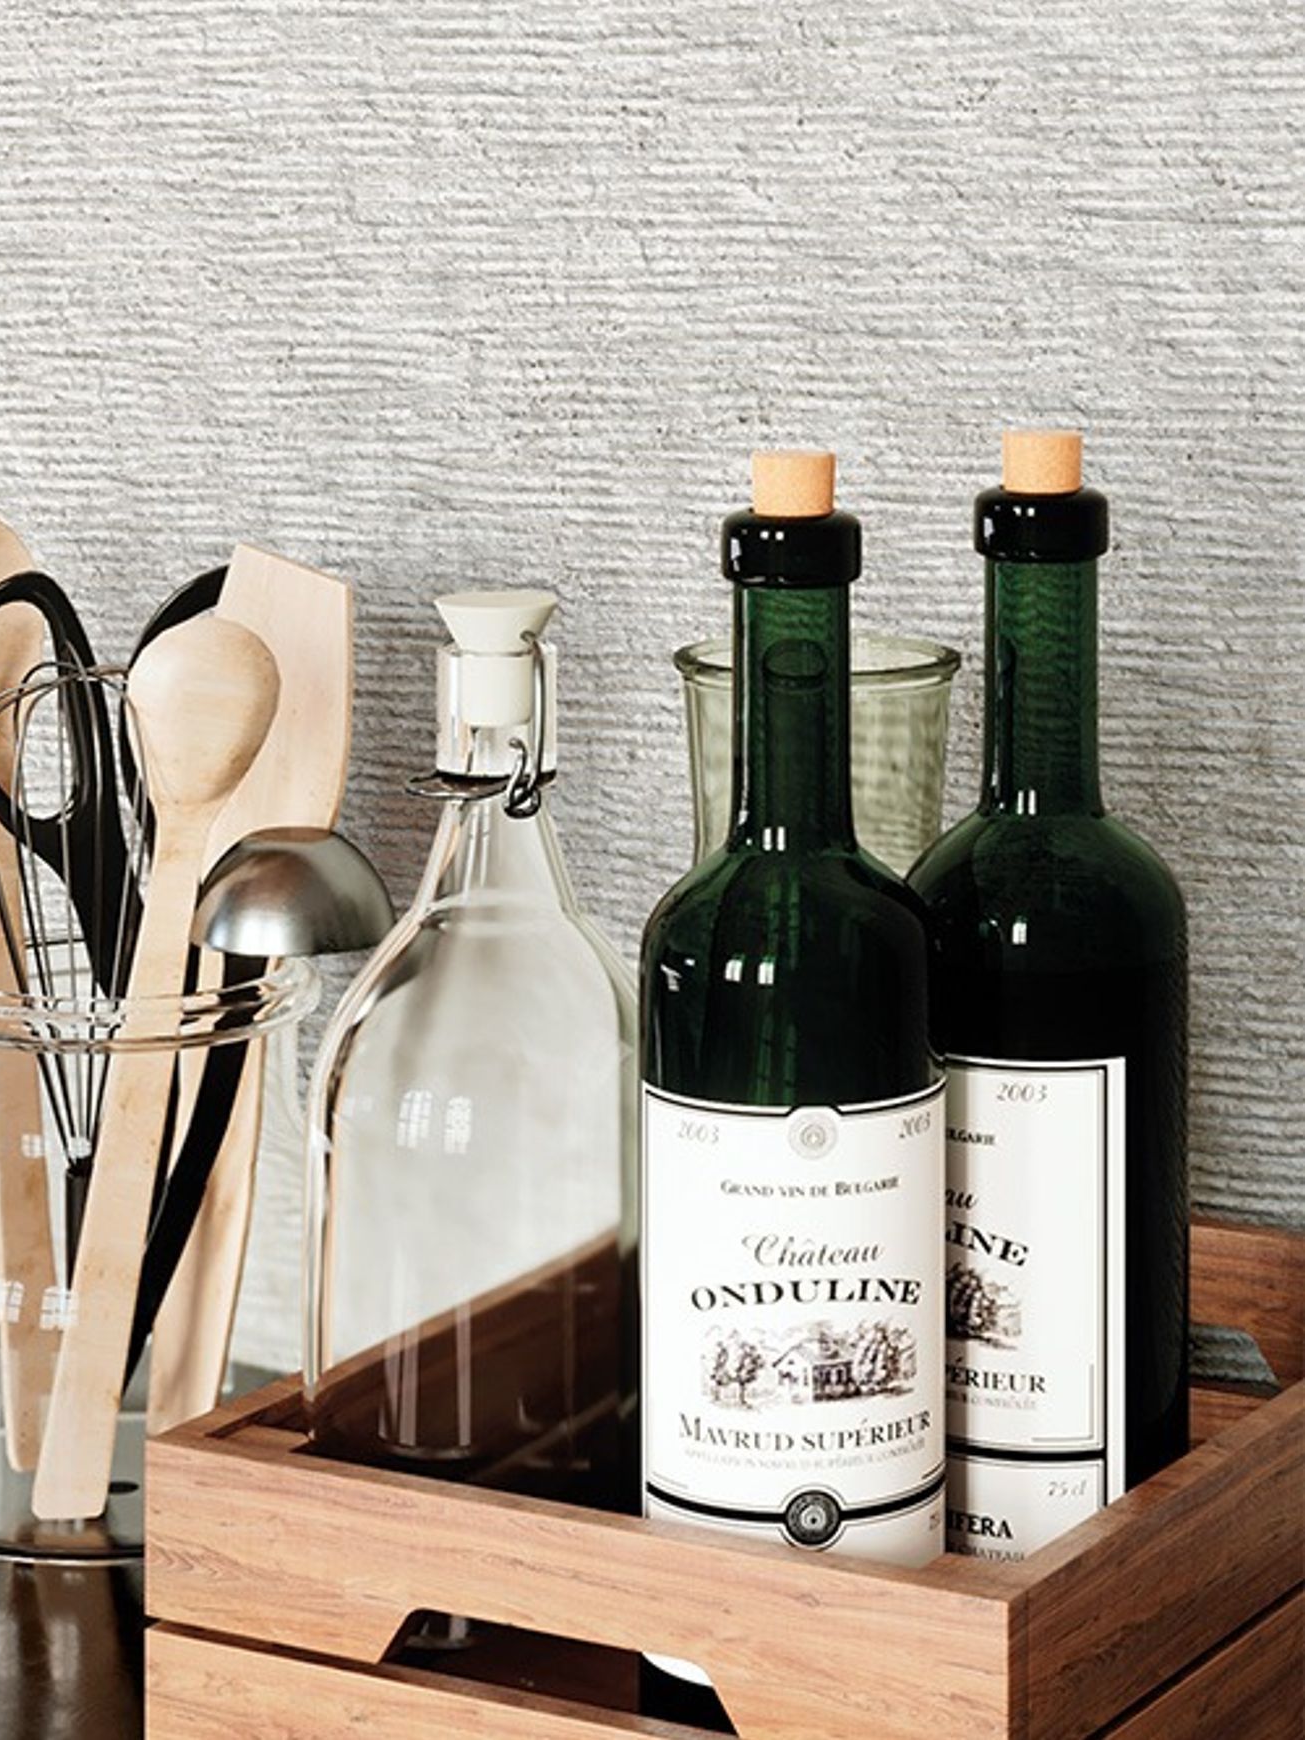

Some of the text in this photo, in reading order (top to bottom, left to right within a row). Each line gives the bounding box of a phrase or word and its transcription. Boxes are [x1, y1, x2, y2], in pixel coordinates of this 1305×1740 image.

[996, 1083, 1048, 1102] 2003
[678, 1121, 720, 1144] 2003
[720, 1179, 775, 1198] GRAND
[778, 1186, 806, 1198] VIN
[809, 1186, 829, 1198] DE
[741, 1233, 885, 1267] Château
[691, 1278, 922, 1312] ONDULINE
[679, 1411, 795, 1452] MAVRUD
[800, 1409, 932, 1452] SUPÉRIEUR
